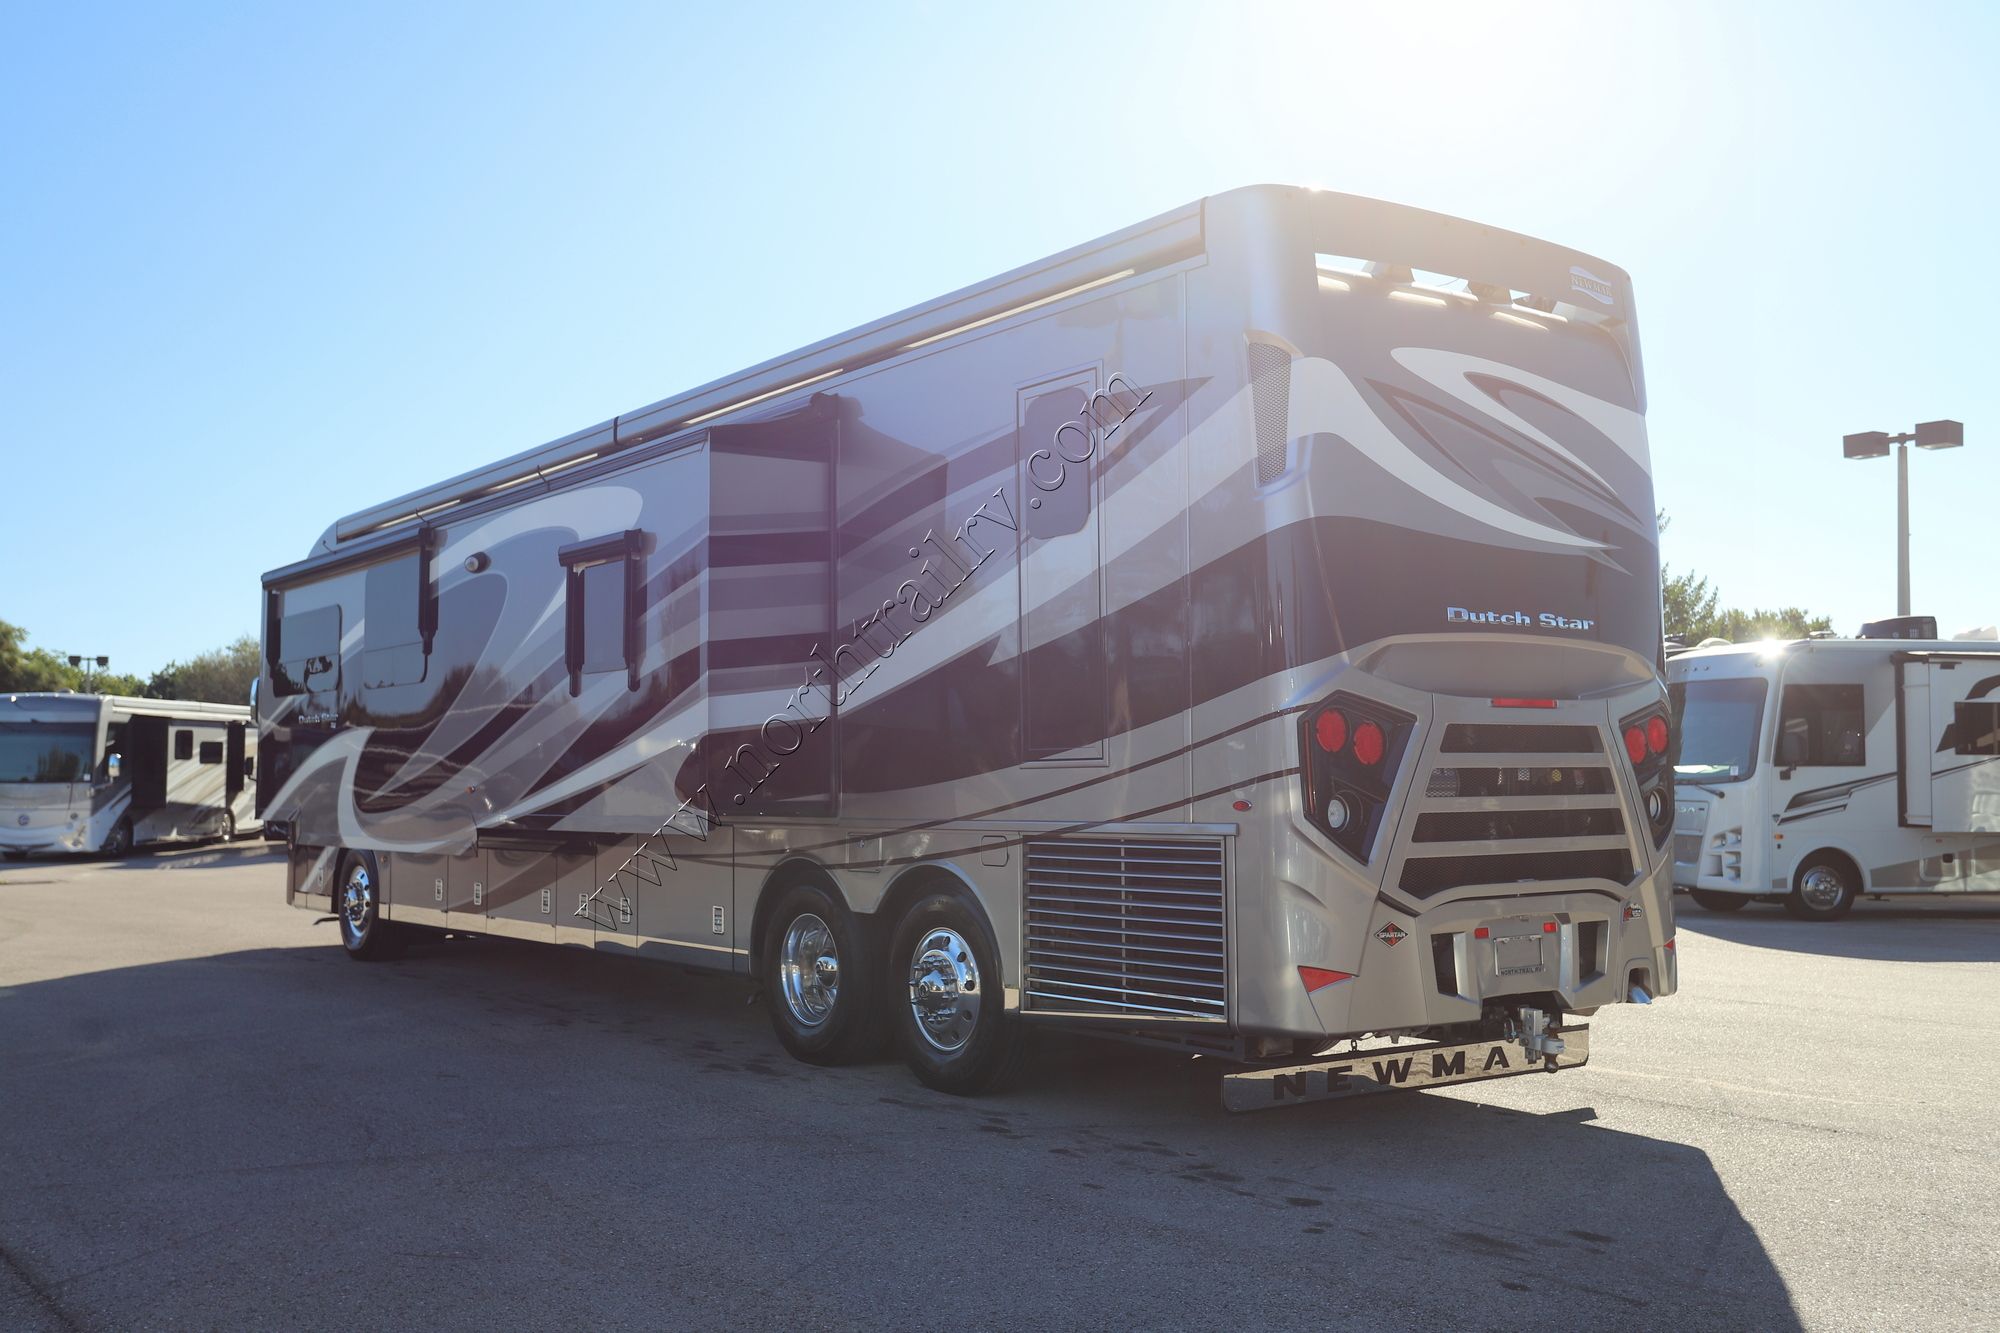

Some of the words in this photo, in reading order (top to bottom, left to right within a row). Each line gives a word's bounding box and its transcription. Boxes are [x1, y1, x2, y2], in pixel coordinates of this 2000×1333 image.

[1447, 606, 1532, 626] Dutch
[1538, 612, 1595, 630] Star
[1379, 930, 1406, 938] SPARTAN
[1273, 1046, 1537, 1100] NEWMA
